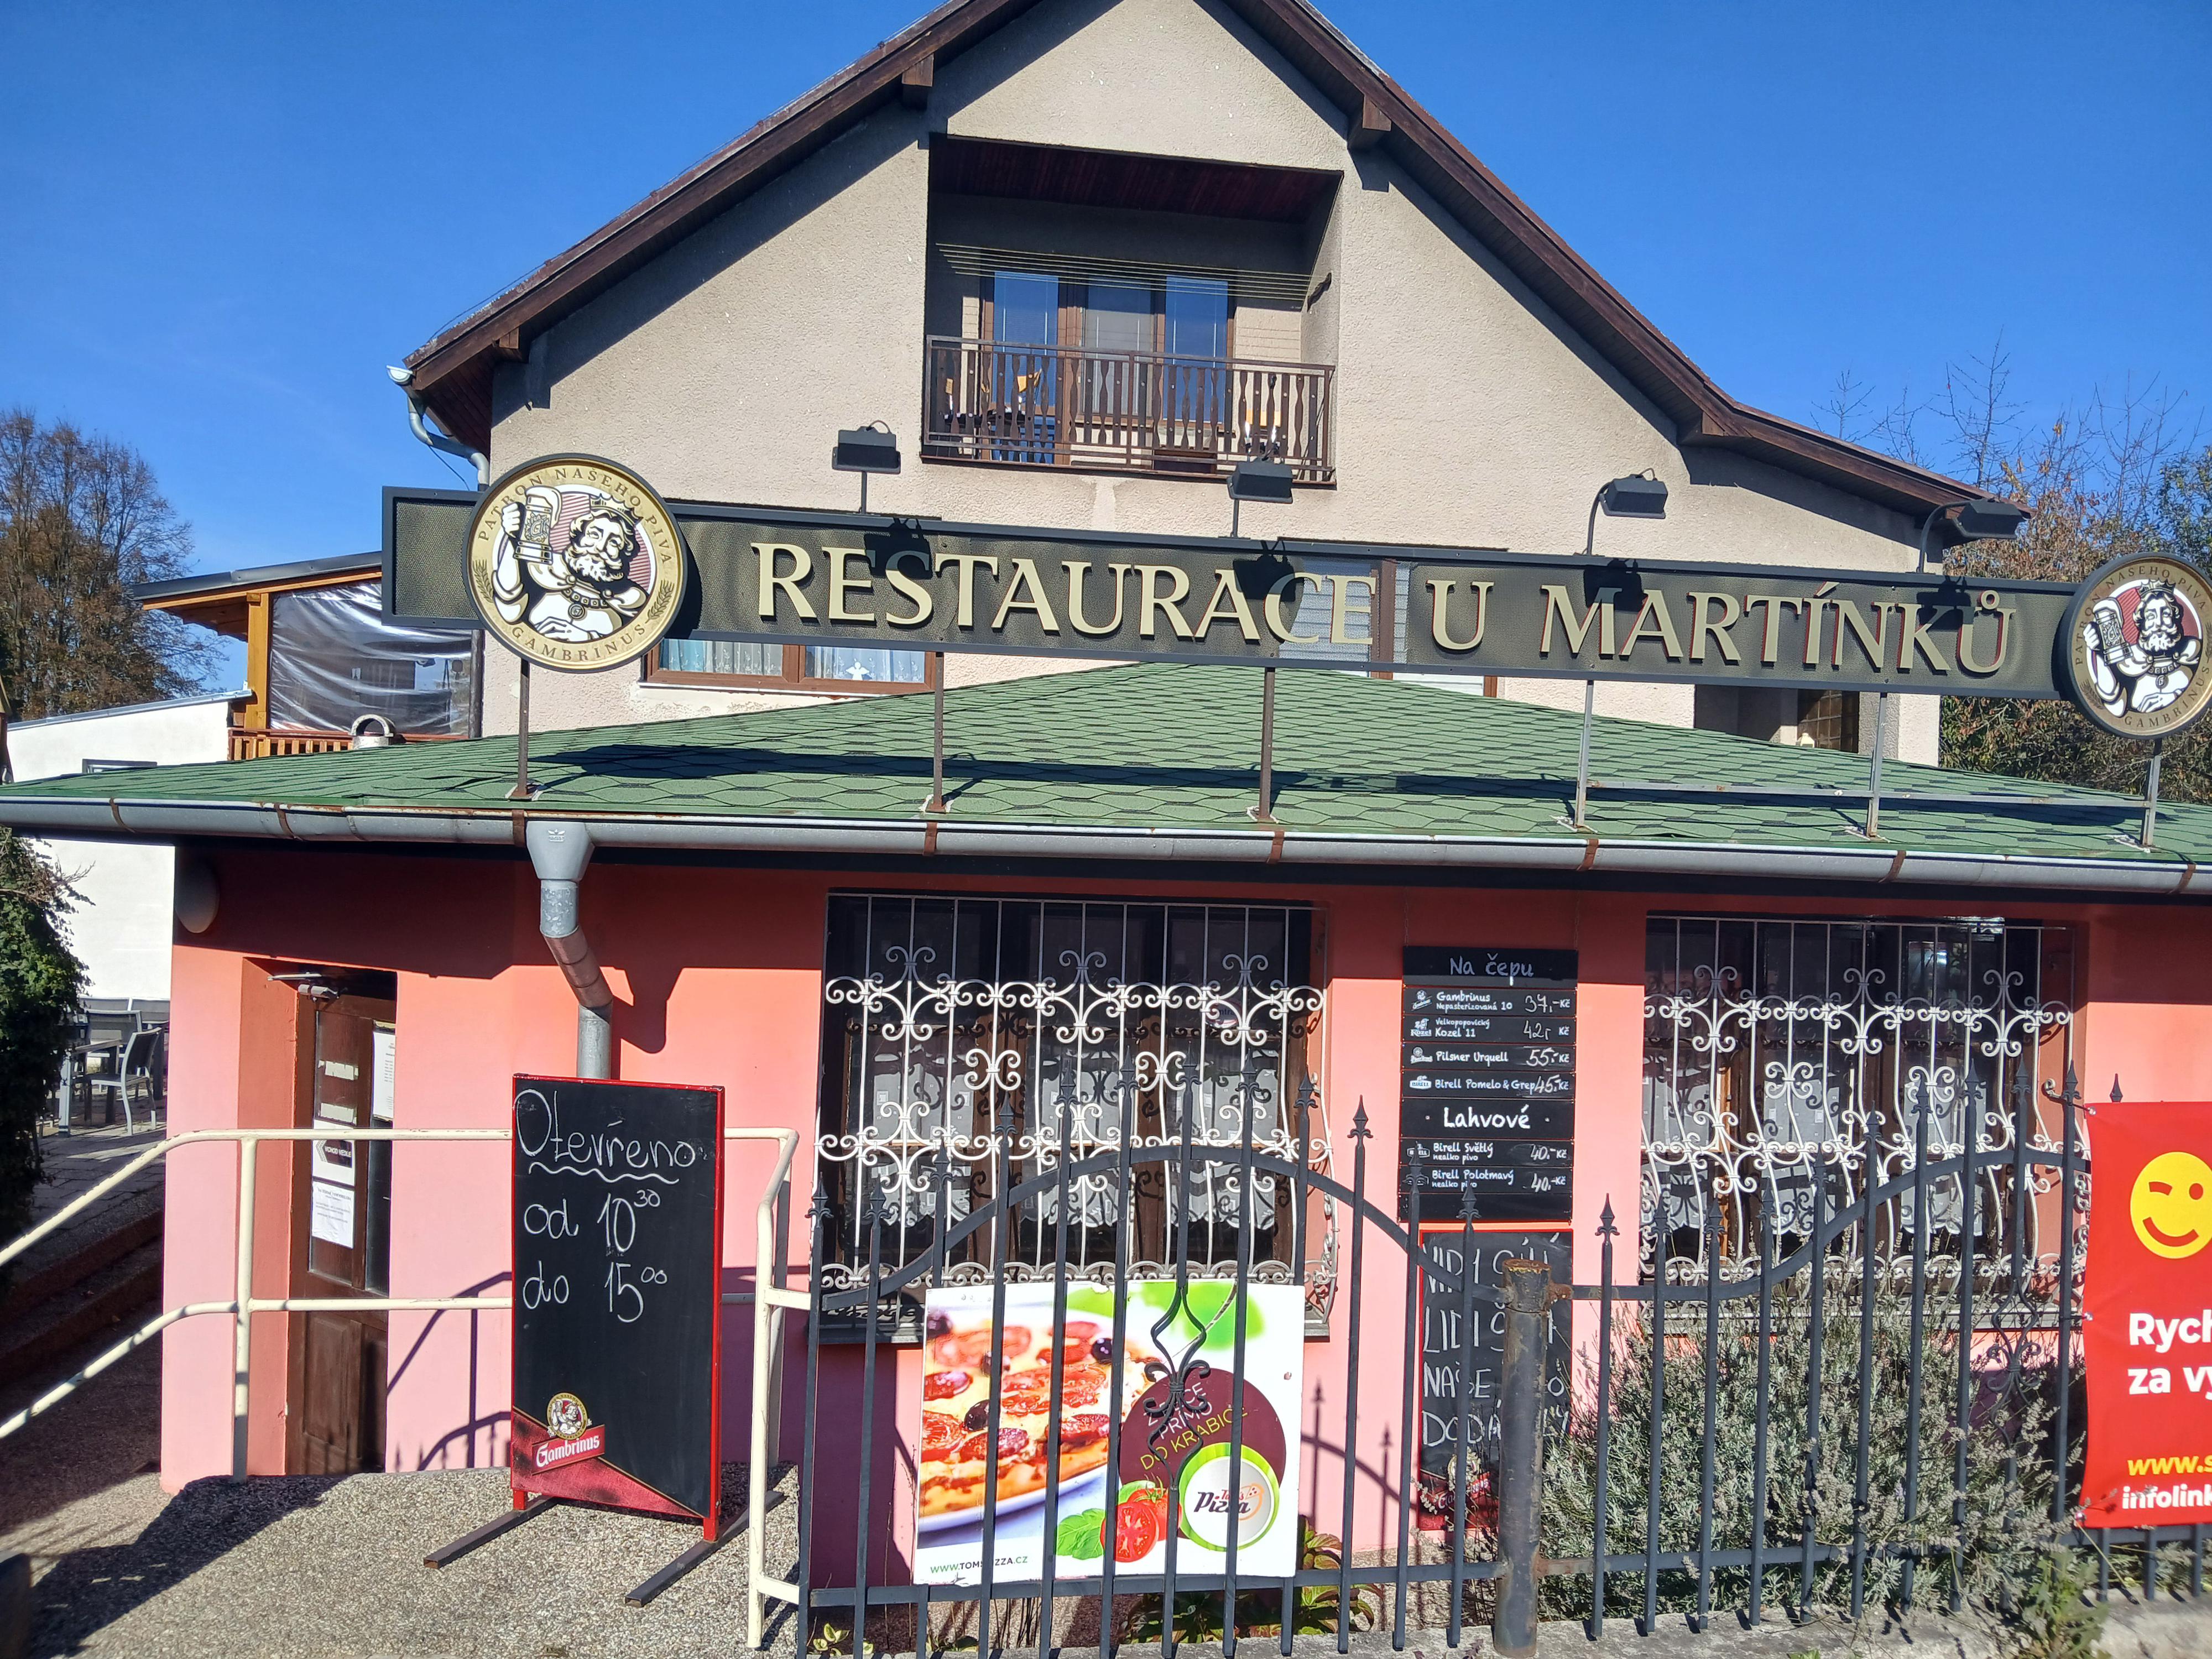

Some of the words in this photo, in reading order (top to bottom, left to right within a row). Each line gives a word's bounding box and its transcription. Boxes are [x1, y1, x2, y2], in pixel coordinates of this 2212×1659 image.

[478, 475, 542, 541] PATRON
[555, 468, 641, 507] NAŠEHO
[645, 515, 672, 564] PIVA
[2178, 578, 2206, 609] PIVA
[751, 542, 1377, 646] RESTAURACE
[1425, 579, 1494, 653] U
[1540, 581, 2017, 674] MARTÍNKŮ
[512, 624, 645, 661] GAMBRINUS
[2124, 666, 2210, 728] GAMBRINUS
[1450, 956, 1475, 975] Na
[1485, 953, 1534, 986] čepu
[1436, 990, 1490, 1002] Gambrinus
[1559, 999, 1570, 1008] Kč
[1436, 1001, 1498, 1013] Nepasterizovaná
[1501, 1001, 1513, 1010] 10
[1436, 1017, 1490, 1029] Velkopopovický
[1558, 1026, 1570, 1036] Kč
[1435, 1027, 1462, 1037] Kozel
[1465, 1028, 1476, 1037] 11
[1436, 1051, 1470, 1062] Pilsner
[1474, 1052, 1509, 1067] Urquell
[1558, 1053, 1570, 1063] Kč
[1434, 1078, 1462, 1089] Birell
[1466, 1079, 1501, 1089] Pomelo
[1503, 1080, 1509, 1089] &
[1511, 1080, 1536, 1095] Grep
[1558, 1081, 1569, 1091] Kč
[1444, 1104, 1530, 1129] Lahvové
[1433, 1142, 1461, 1152] Birell
[1464, 1141, 1494, 1158] Světlý
[1556, 1149, 1567, 1159] Kč
[1462, 1154, 1479, 1165] pivo
[1432, 1169, 1459, 1180] Birell
[1463, 1169, 1514, 1186] Polotmavý
[1555, 1176, 1566, 1185] Kč
[1461, 1181, 1478, 1192] pio
[524, 1198, 579, 1239] od
[523, 1260, 570, 1310] do
[2127, 1367, 2171, 1395] za
[1140, 1447, 1168, 1470] DO
[1171, 1407, 1248, 1453] KRABIC
[535, 1434, 601, 1468] Gambrinus
[930, 1556, 1028, 1574] WWW.TOMZZA.CZ
